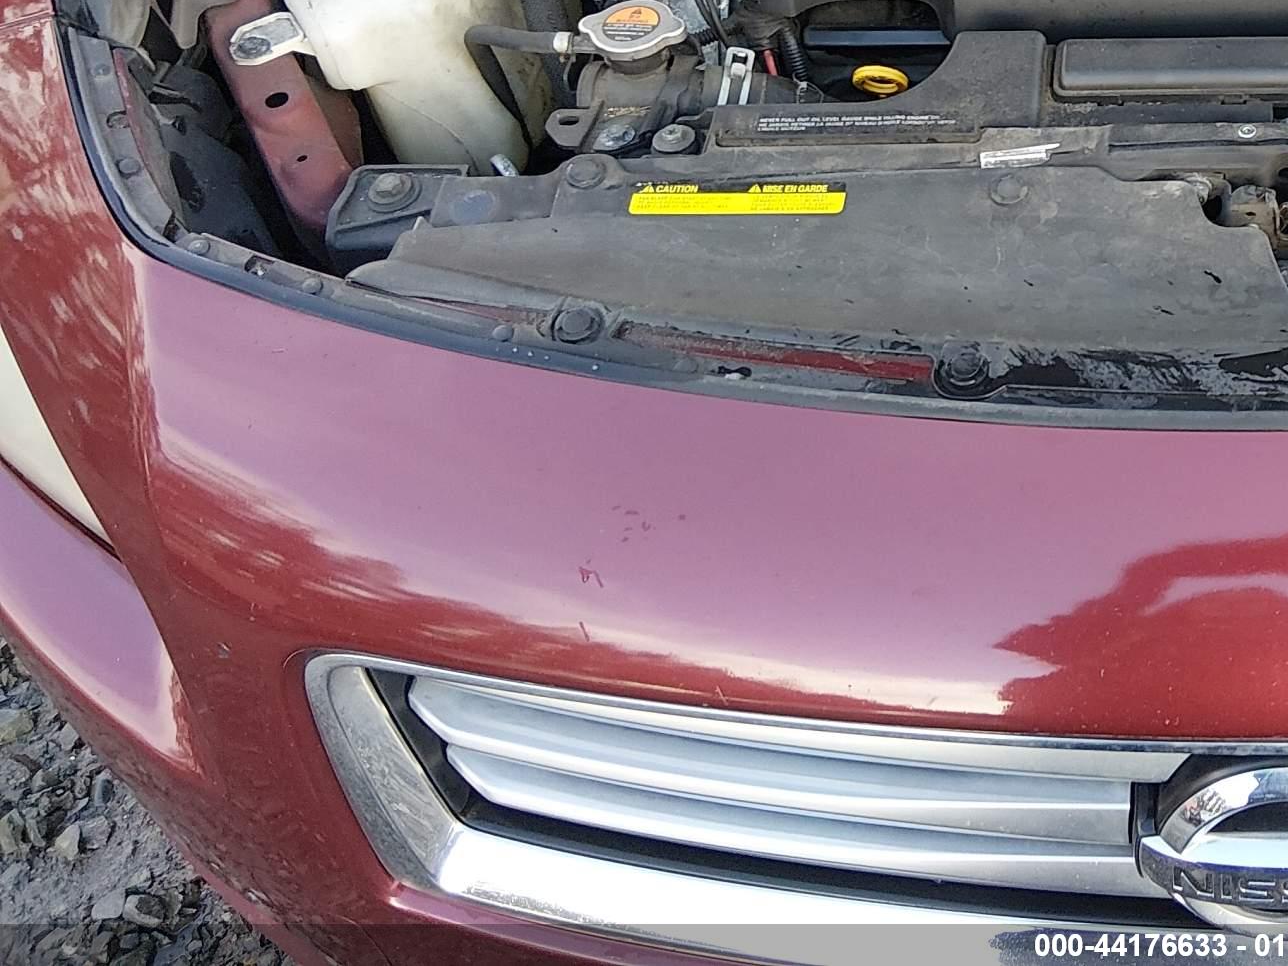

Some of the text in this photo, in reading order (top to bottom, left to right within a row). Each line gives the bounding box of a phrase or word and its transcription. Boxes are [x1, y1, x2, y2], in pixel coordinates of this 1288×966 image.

[656, 185, 699, 193] CAUTION
[784, 185, 797, 193] EN
[798, 184, 828, 193] GARDE
